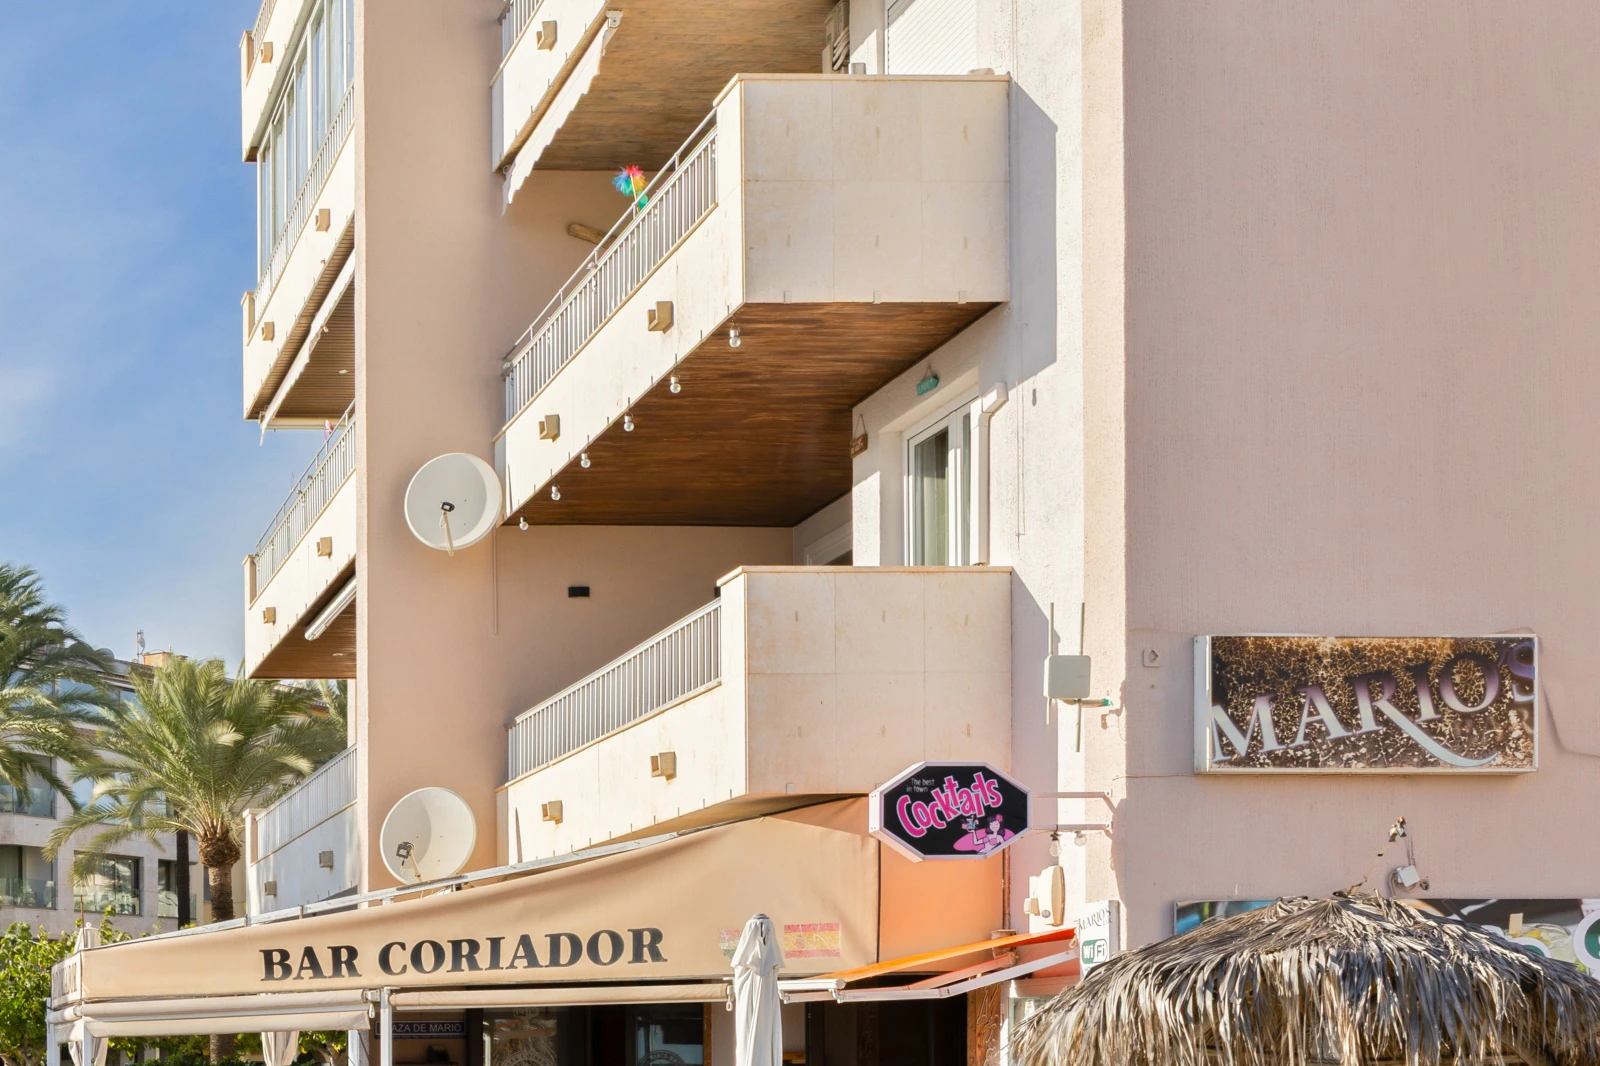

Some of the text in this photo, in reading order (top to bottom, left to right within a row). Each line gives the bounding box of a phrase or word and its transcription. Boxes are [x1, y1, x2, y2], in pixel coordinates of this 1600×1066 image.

[1211, 640, 1536, 768] MARIO'S
[896, 771, 1003, 838] Cocktails
[911, 777, 935, 786] The best
[259, 927, 668, 982] BAR CORIADOR
[413, 1023, 427, 1033] DE
[429, 1022, 462, 1033] MARIO
